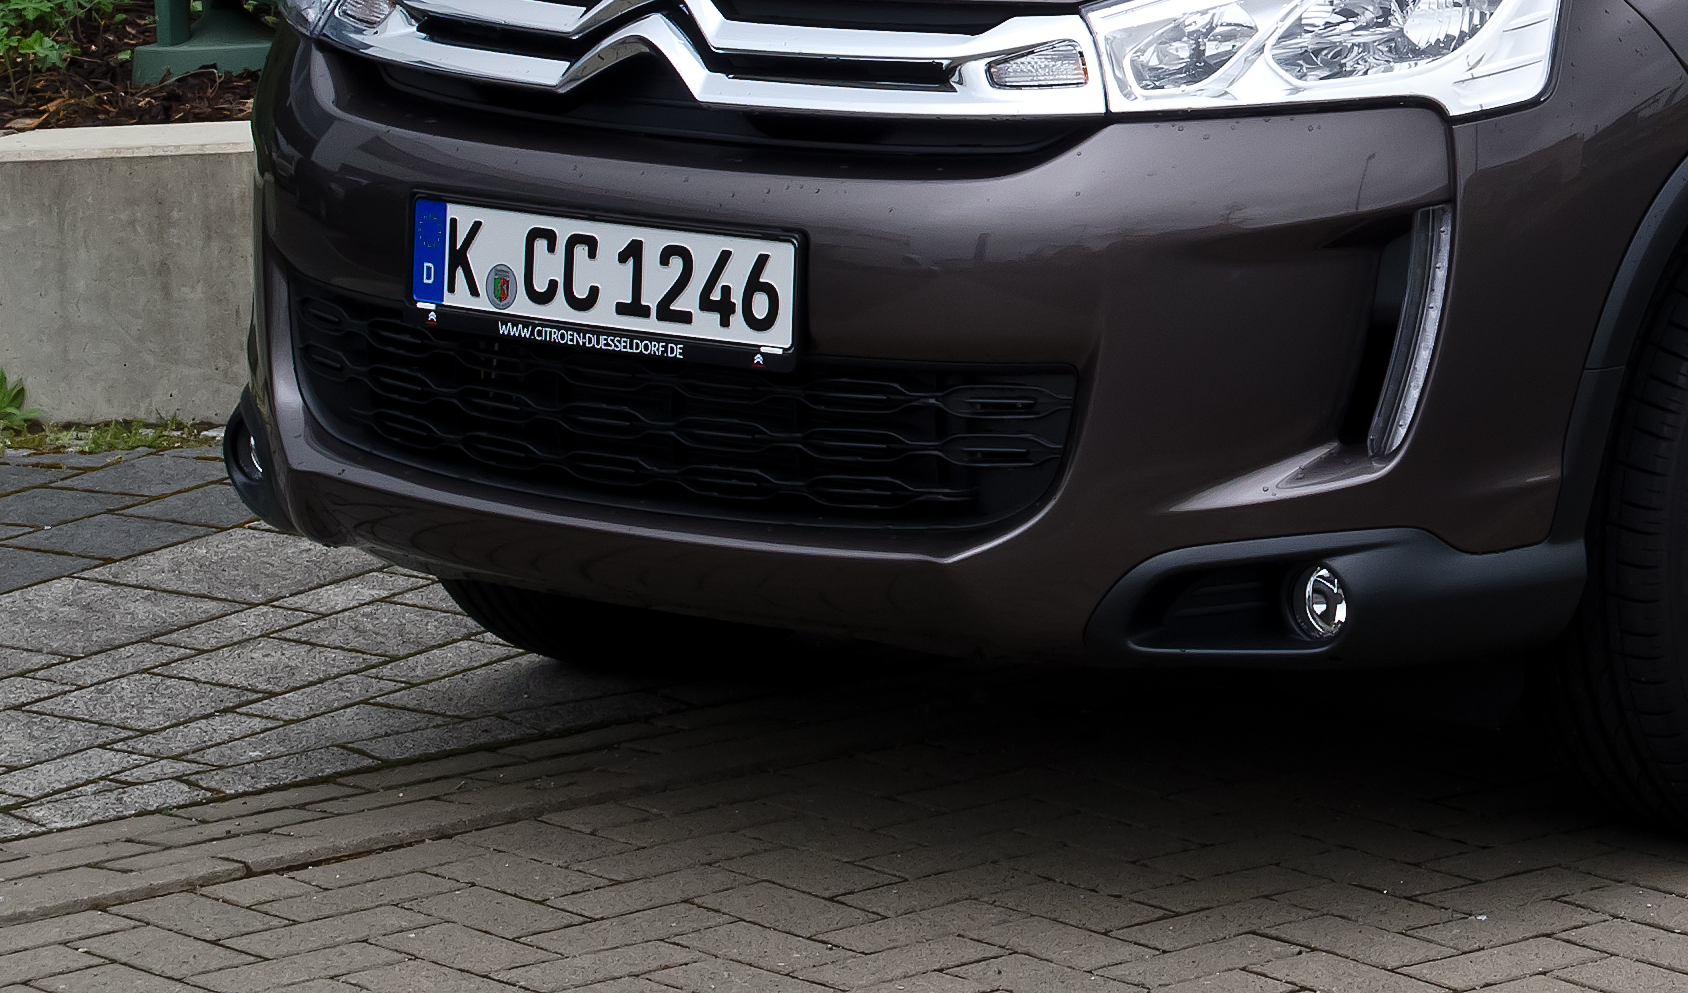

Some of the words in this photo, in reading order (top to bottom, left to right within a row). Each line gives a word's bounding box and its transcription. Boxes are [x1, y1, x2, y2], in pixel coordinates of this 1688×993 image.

[423, 261, 435, 284] D
[447, 216, 484, 299] K
[523, 226, 600, 312] CC
[614, 238, 780, 333] 1246
[498, 321, 684, 359] WWW.CITROEN-DUESSELDORF.DE
